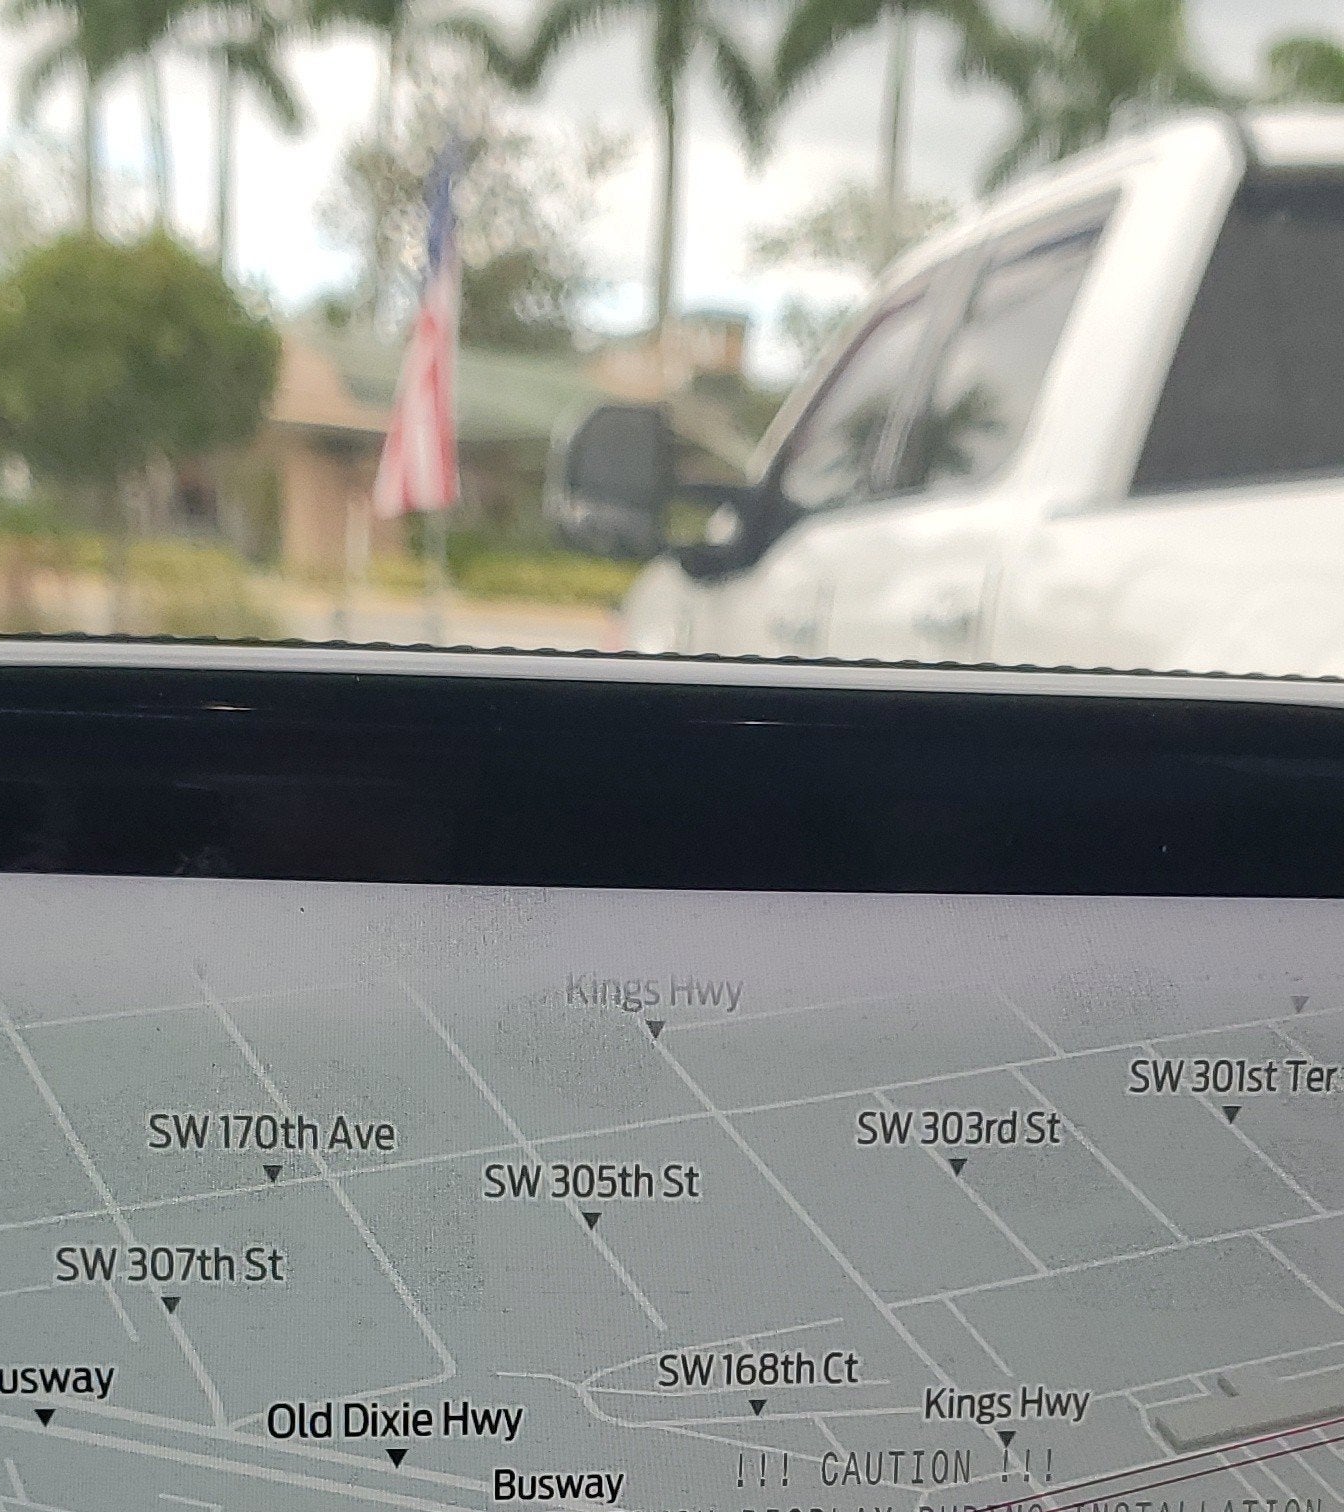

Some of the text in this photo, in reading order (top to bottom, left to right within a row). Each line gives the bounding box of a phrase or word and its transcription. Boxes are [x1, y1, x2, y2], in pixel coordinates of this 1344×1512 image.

[567, 972, 744, 1014] Kings Hwy
[1129, 1060, 1339, 1093] SW 301st Ter
[150, 1114, 395, 1150] SW 170th Ave
[857, 1111, 1060, 1145] SW 303rd St
[485, 1164, 700, 1198] SW 305th St
[56, 1247, 284, 1282] SW 307th St
[657, 1353, 859, 1387] SW 168th Ct
[267, 1402, 524, 1442] Old Dixie Hwy
[924, 1387, 1089, 1424] Kings Hwy
[735, 1450, 1055, 1488] !!! CAUTION !!!
[493, 1470, 625, 1505] Busway
